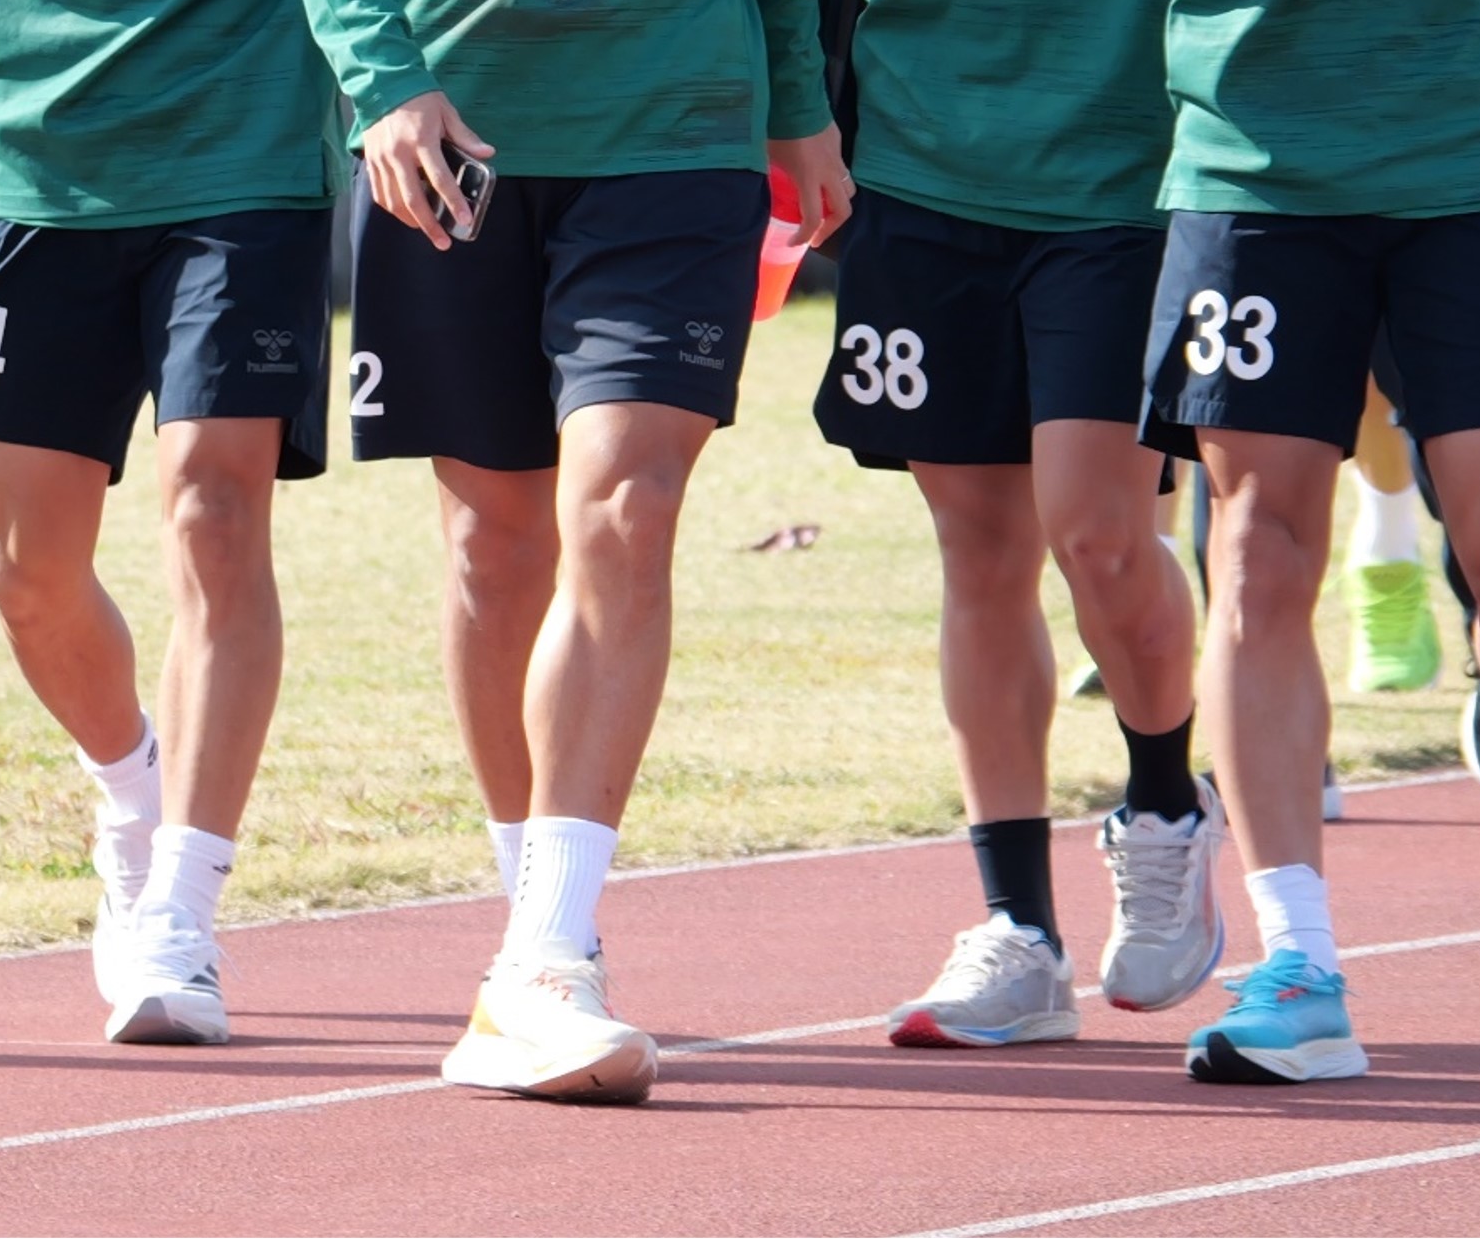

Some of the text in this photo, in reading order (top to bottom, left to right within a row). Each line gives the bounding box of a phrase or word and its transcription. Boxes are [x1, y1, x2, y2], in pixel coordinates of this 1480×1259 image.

[679, 350, 725, 370] hummel
[840, 324, 928, 410] 38
[1185, 289, 1277, 380] 33
[349, 351, 384, 416] 2
